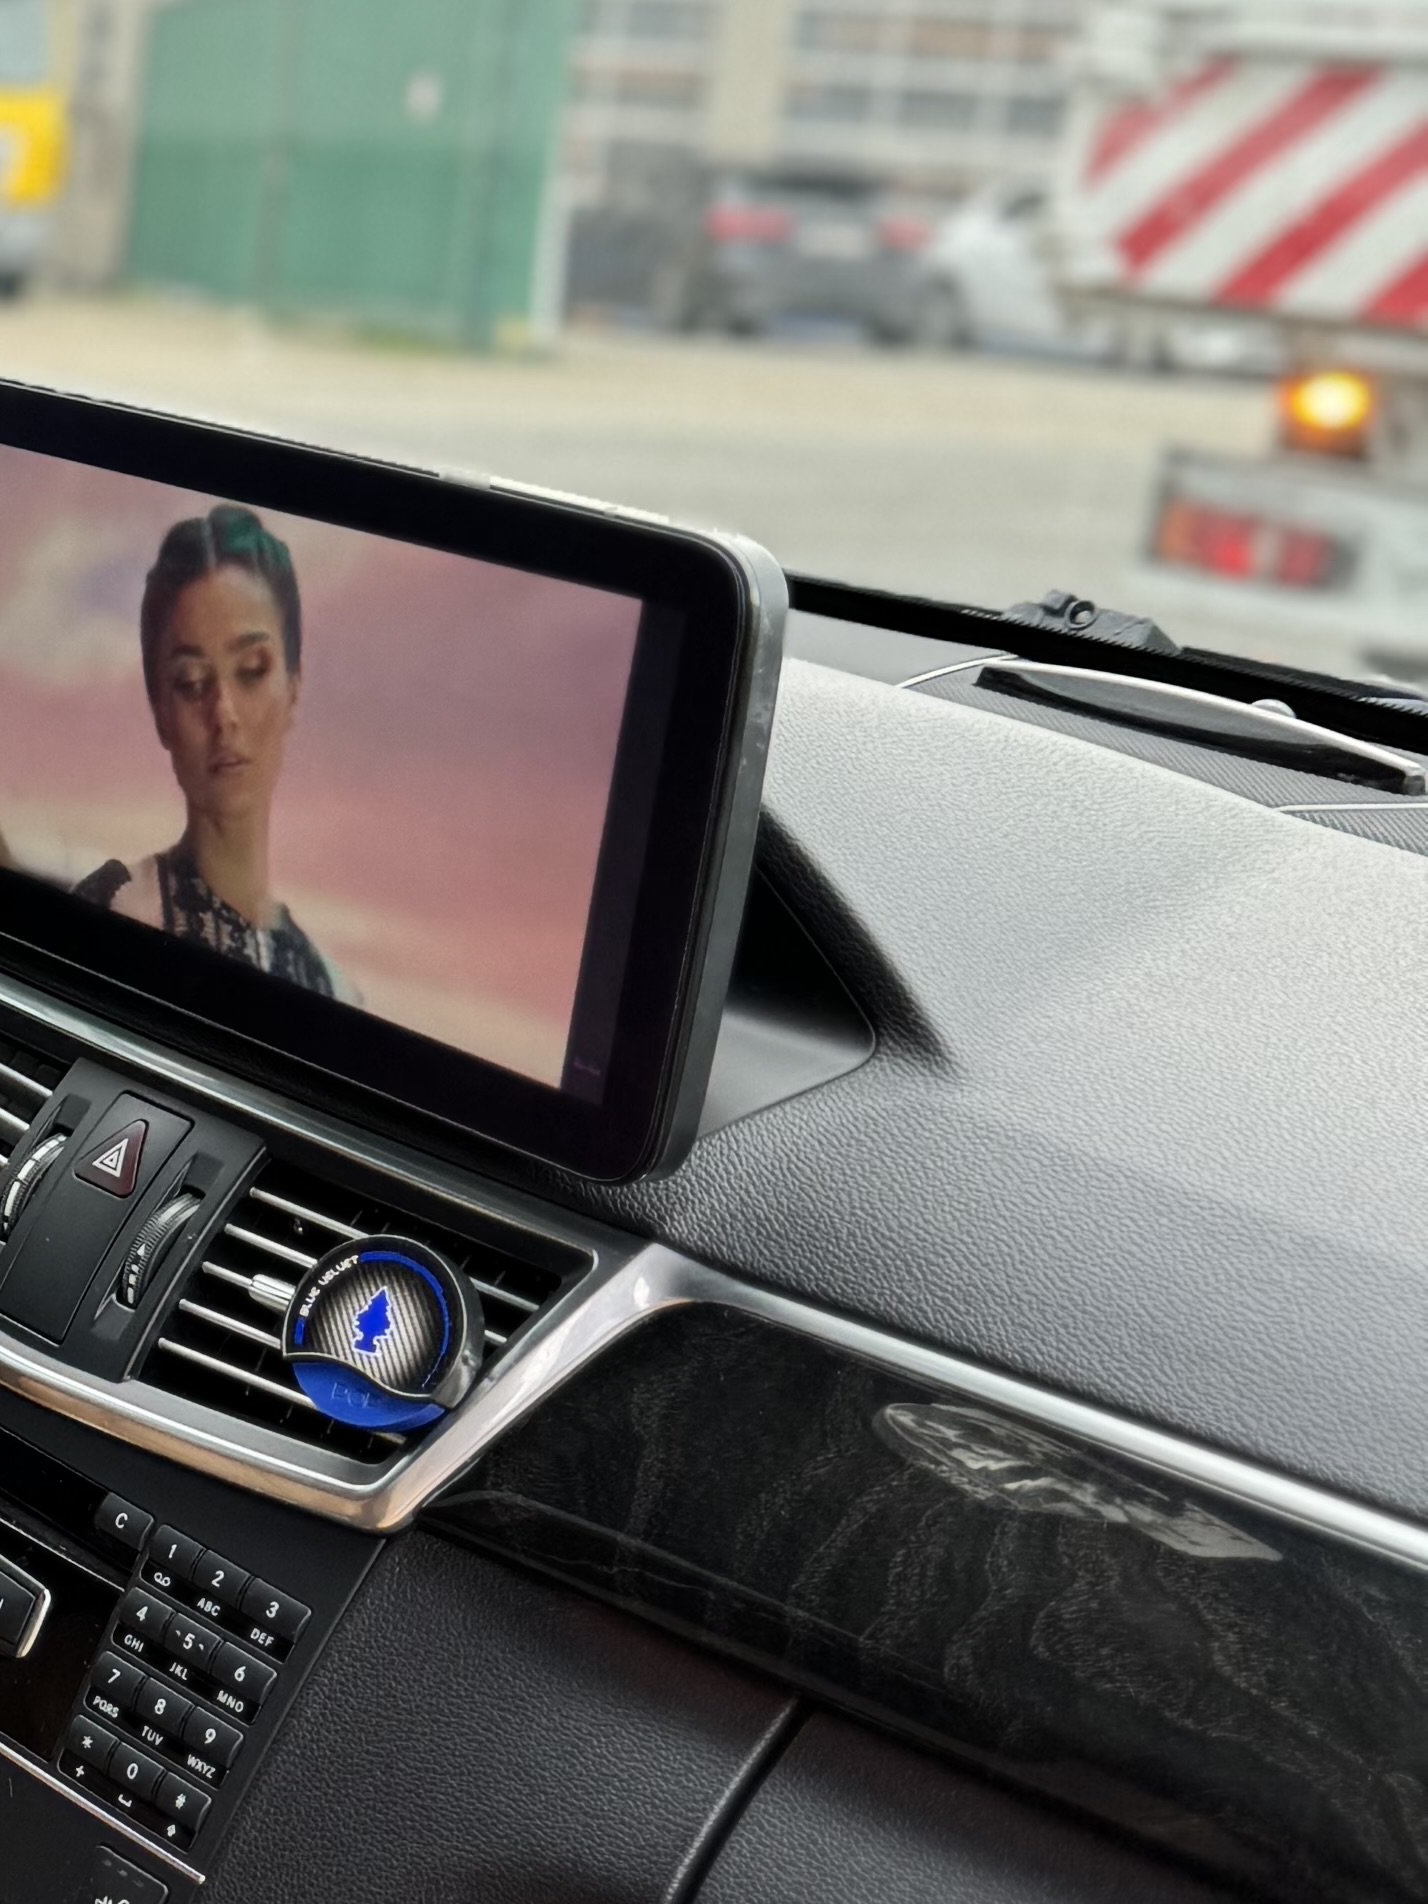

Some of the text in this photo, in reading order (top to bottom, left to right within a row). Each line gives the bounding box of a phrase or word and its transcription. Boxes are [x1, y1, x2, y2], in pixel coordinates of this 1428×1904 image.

[114, 1512, 128, 1529] C
[168, 1543, 178, 1559] 1
[211, 1570, 225, 1588] 2
[135, 1605, 149, 1622] 4
[197, 1596, 221, 1617] ABC
[266, 1601, 280, 1619] 3
[124, 1634, 145, 1653] GHI
[182, 1632, 196, 1650] 5
[250, 1627, 275, 1647] DEF
[108, 1668, 121, 1684] 7
[168, 1661, 189, 1681] JKL
[233, 1666, 247, 1682] 6
[92, 1695, 119, 1718] PQRS
[153, 1698, 167, 1715] 8
[216, 1690, 244, 1714] MNO
[141, 1725, 164, 1746] TUV
[204, 1728, 217, 1745] 9
[126, 1762, 139, 1780] 0
[187, 1754, 217, 1779] WXYZ
[174, 1793, 187, 1809] #
